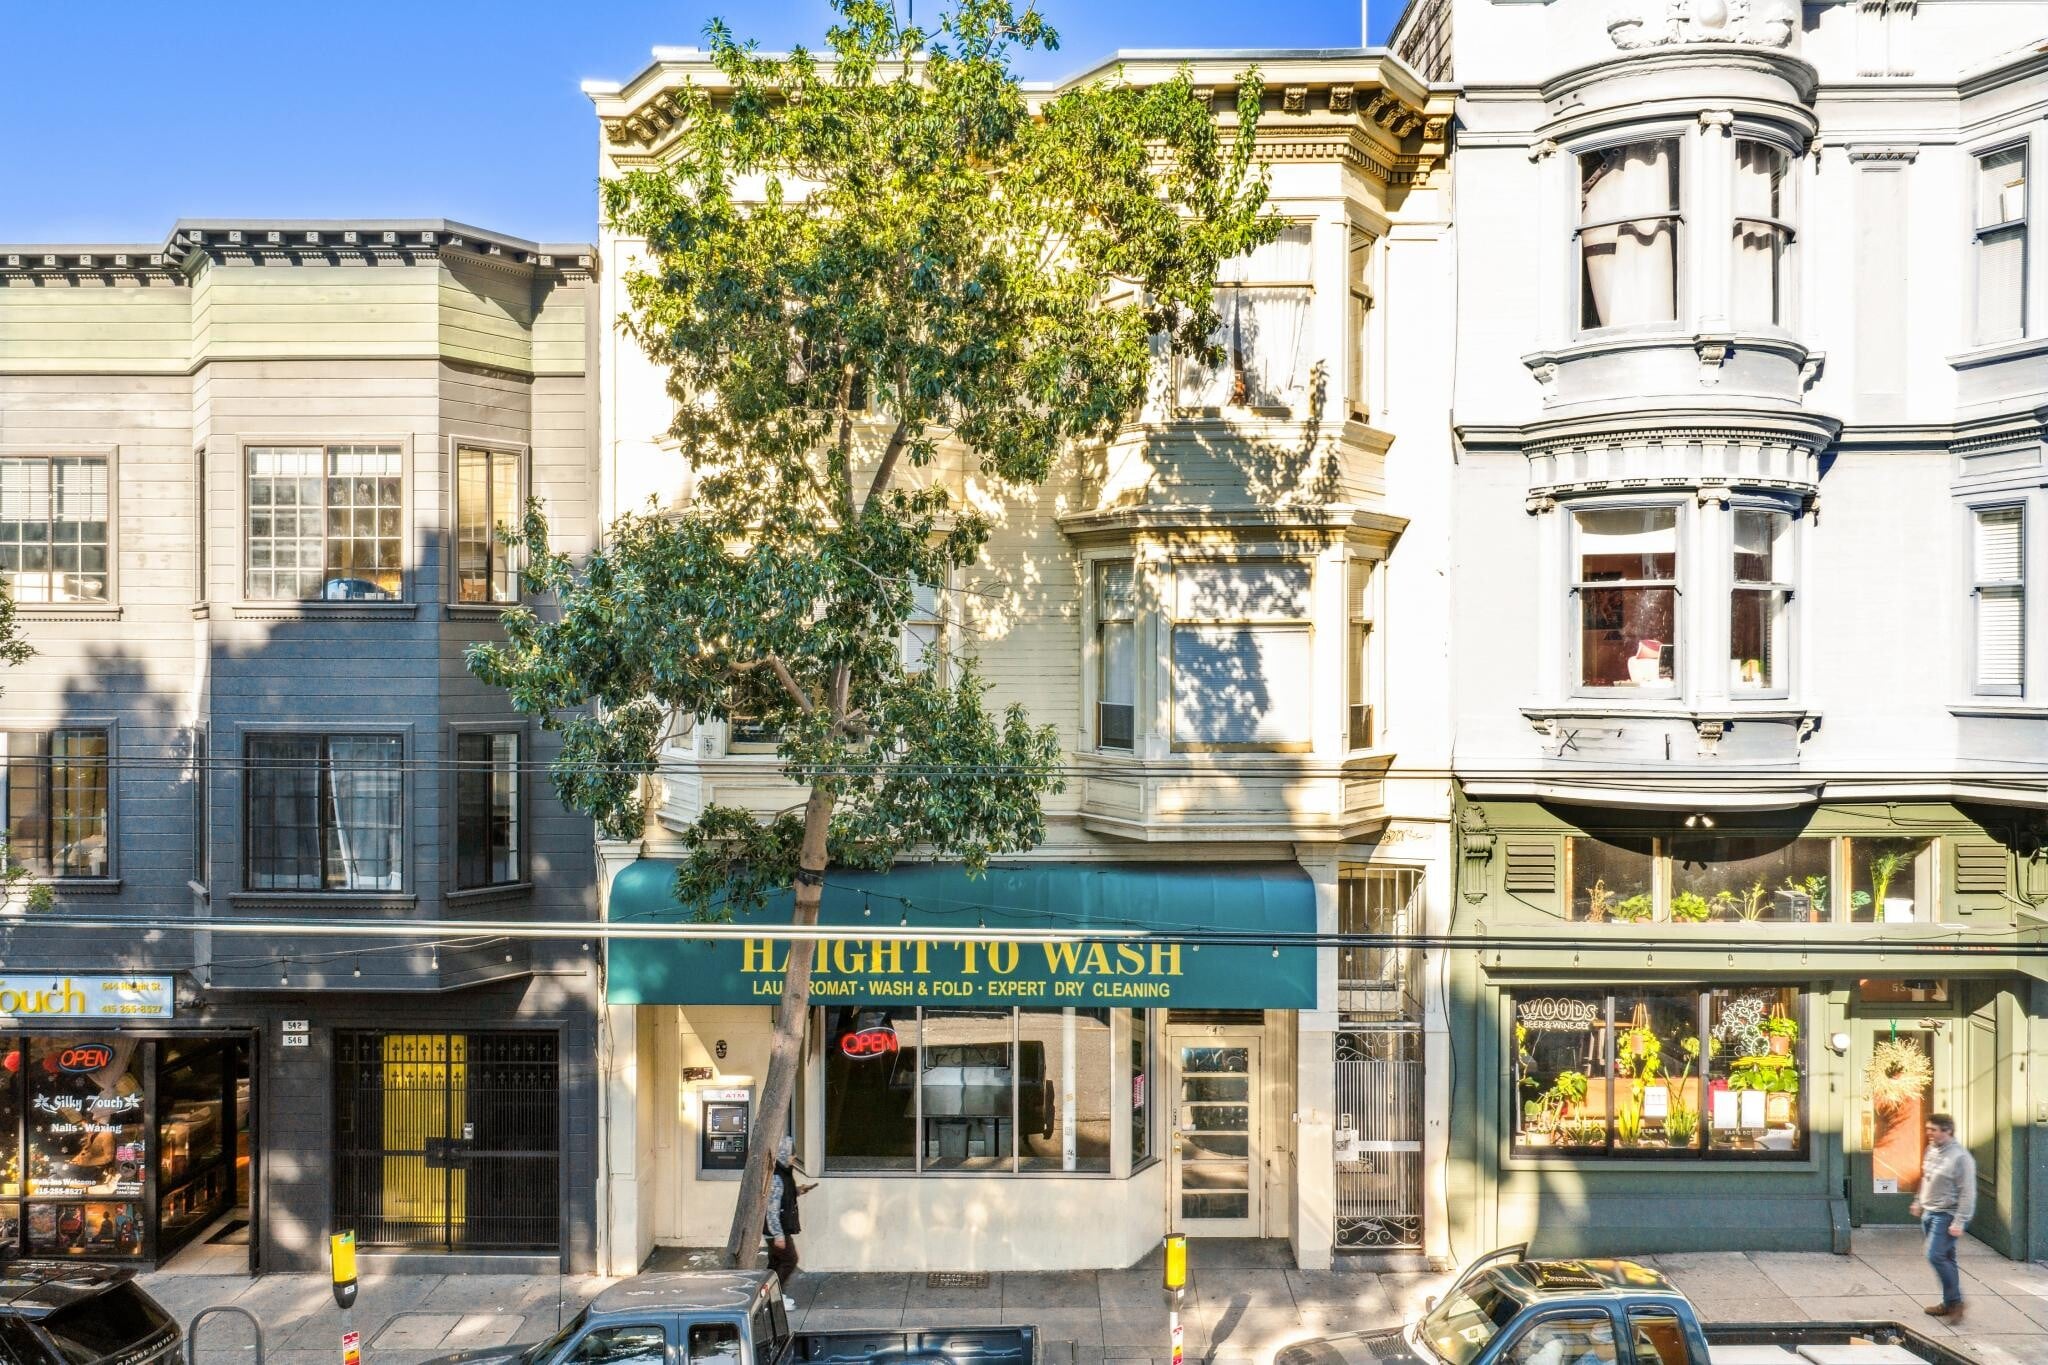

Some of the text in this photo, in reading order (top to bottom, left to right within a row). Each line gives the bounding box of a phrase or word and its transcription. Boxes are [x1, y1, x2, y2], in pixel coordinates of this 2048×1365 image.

[740, 937, 1184, 976] HIGHT TO WASH
[0, 978, 86, 1014] ouch
[752, 980, 1171, 998] LAUROMAT WASH & FOLD EXPERT DRY CLEANING
[1517, 997, 1599, 1021] WOODS
[287, 1021, 302, 1030] 542
[841, 1033, 897, 1053] OPEN
[60, 1049, 109, 1068] OPEN
[50, 1095, 123, 1112] Silky Touch
[51, 1123, 78, 1132] Nails
[85, 1123, 122, 1134] Waxing
[151, 1332, 175, 1351] ROVER
